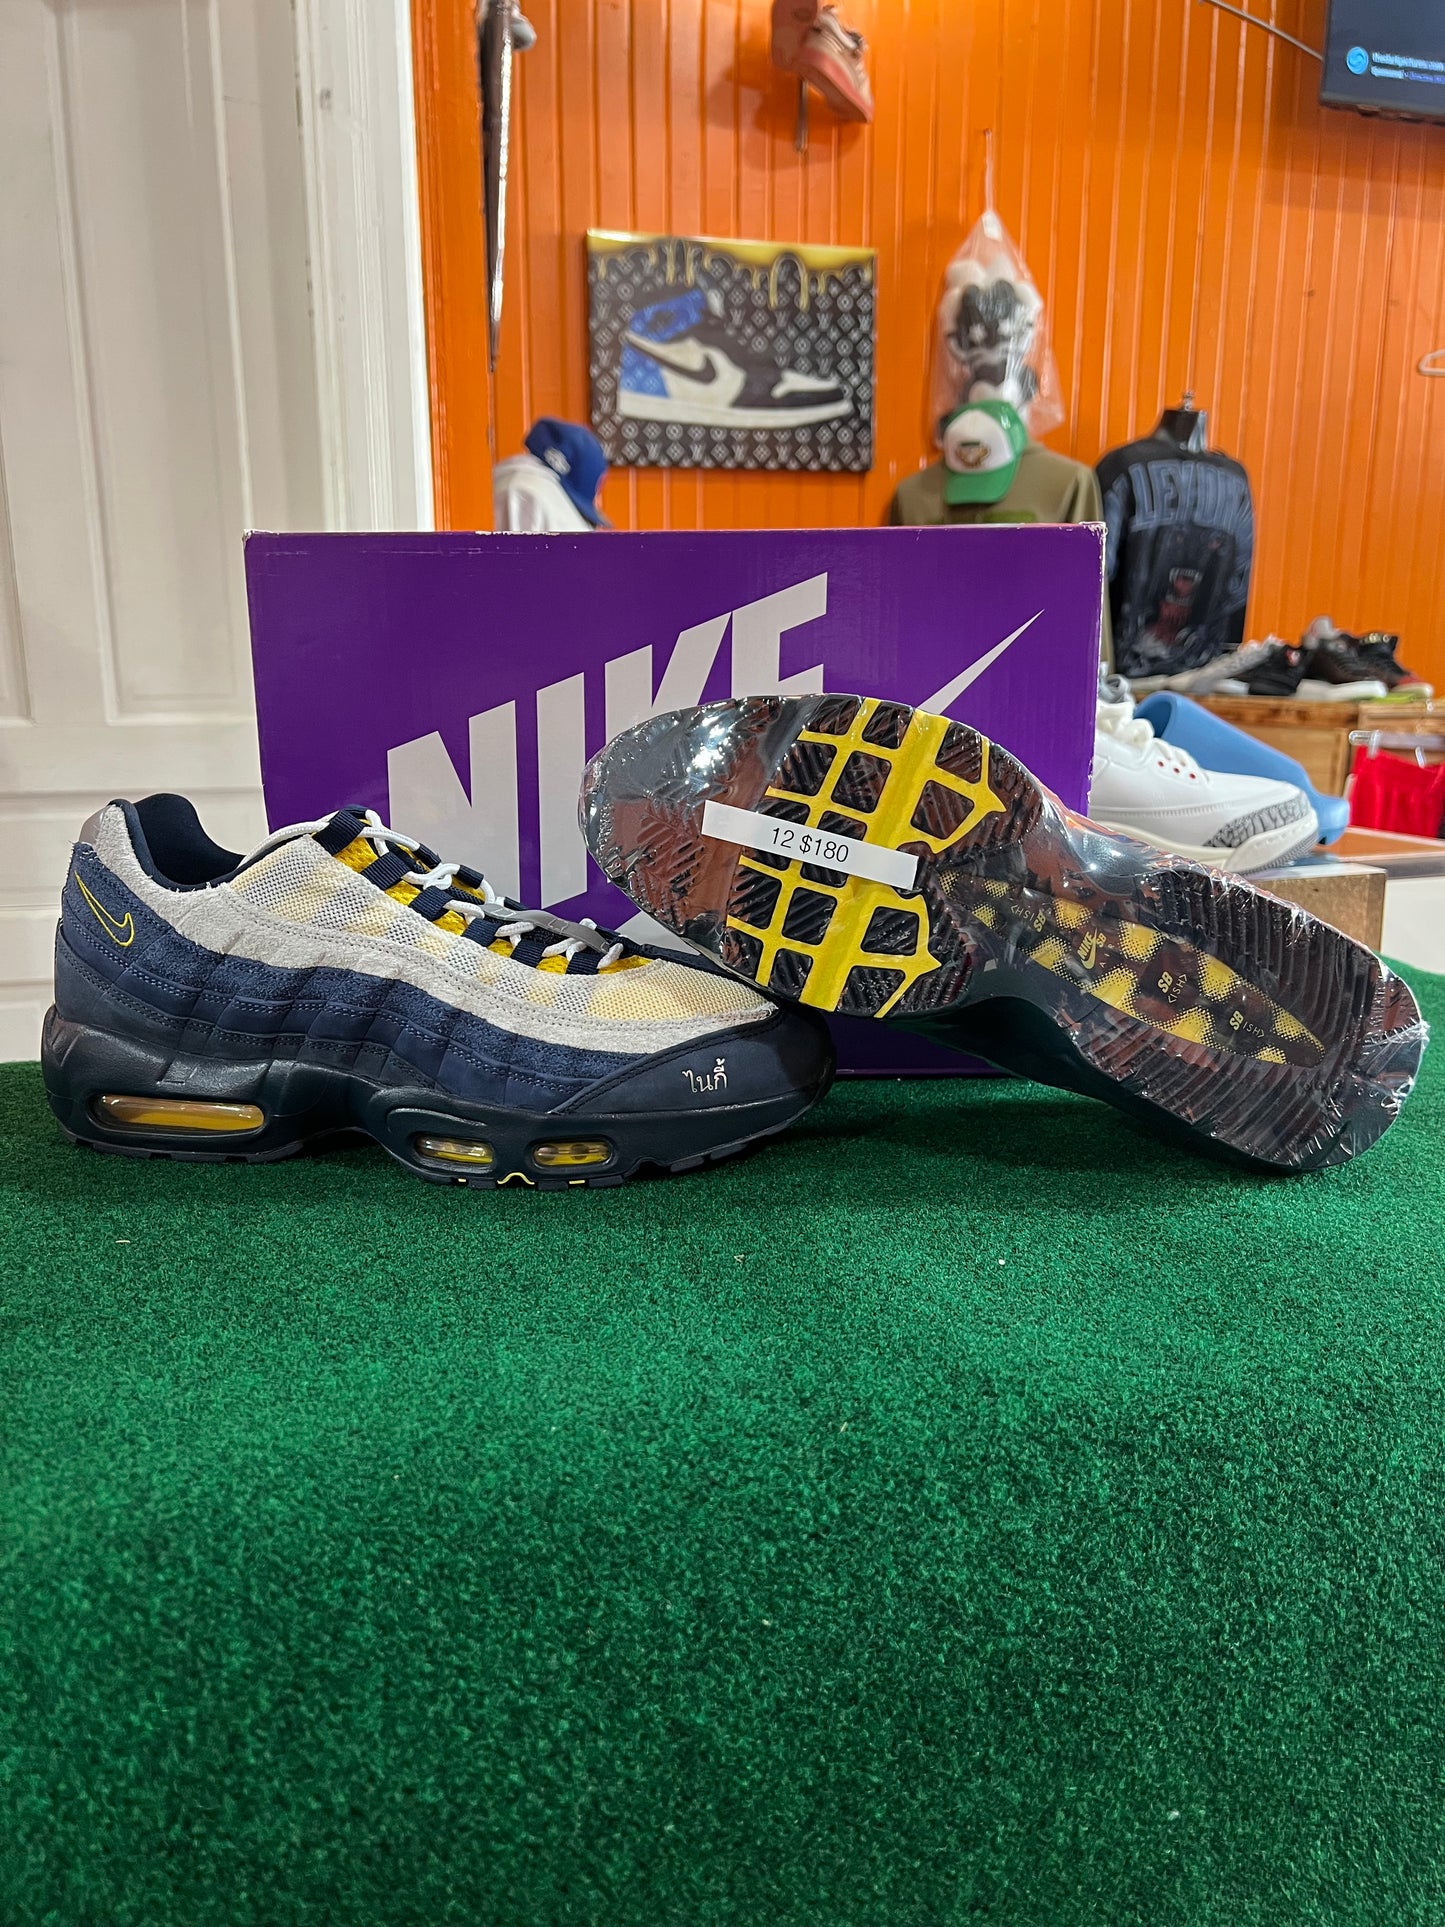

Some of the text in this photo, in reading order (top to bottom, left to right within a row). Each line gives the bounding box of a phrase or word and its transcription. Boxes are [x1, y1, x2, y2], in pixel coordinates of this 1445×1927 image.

[772, 827, 850, 863] 12 $180
[1157, 971, 1173, 993] SB
[1229, 1010, 1244, 1031] SB
[682, 1057, 728, 1093] ไนกี้
